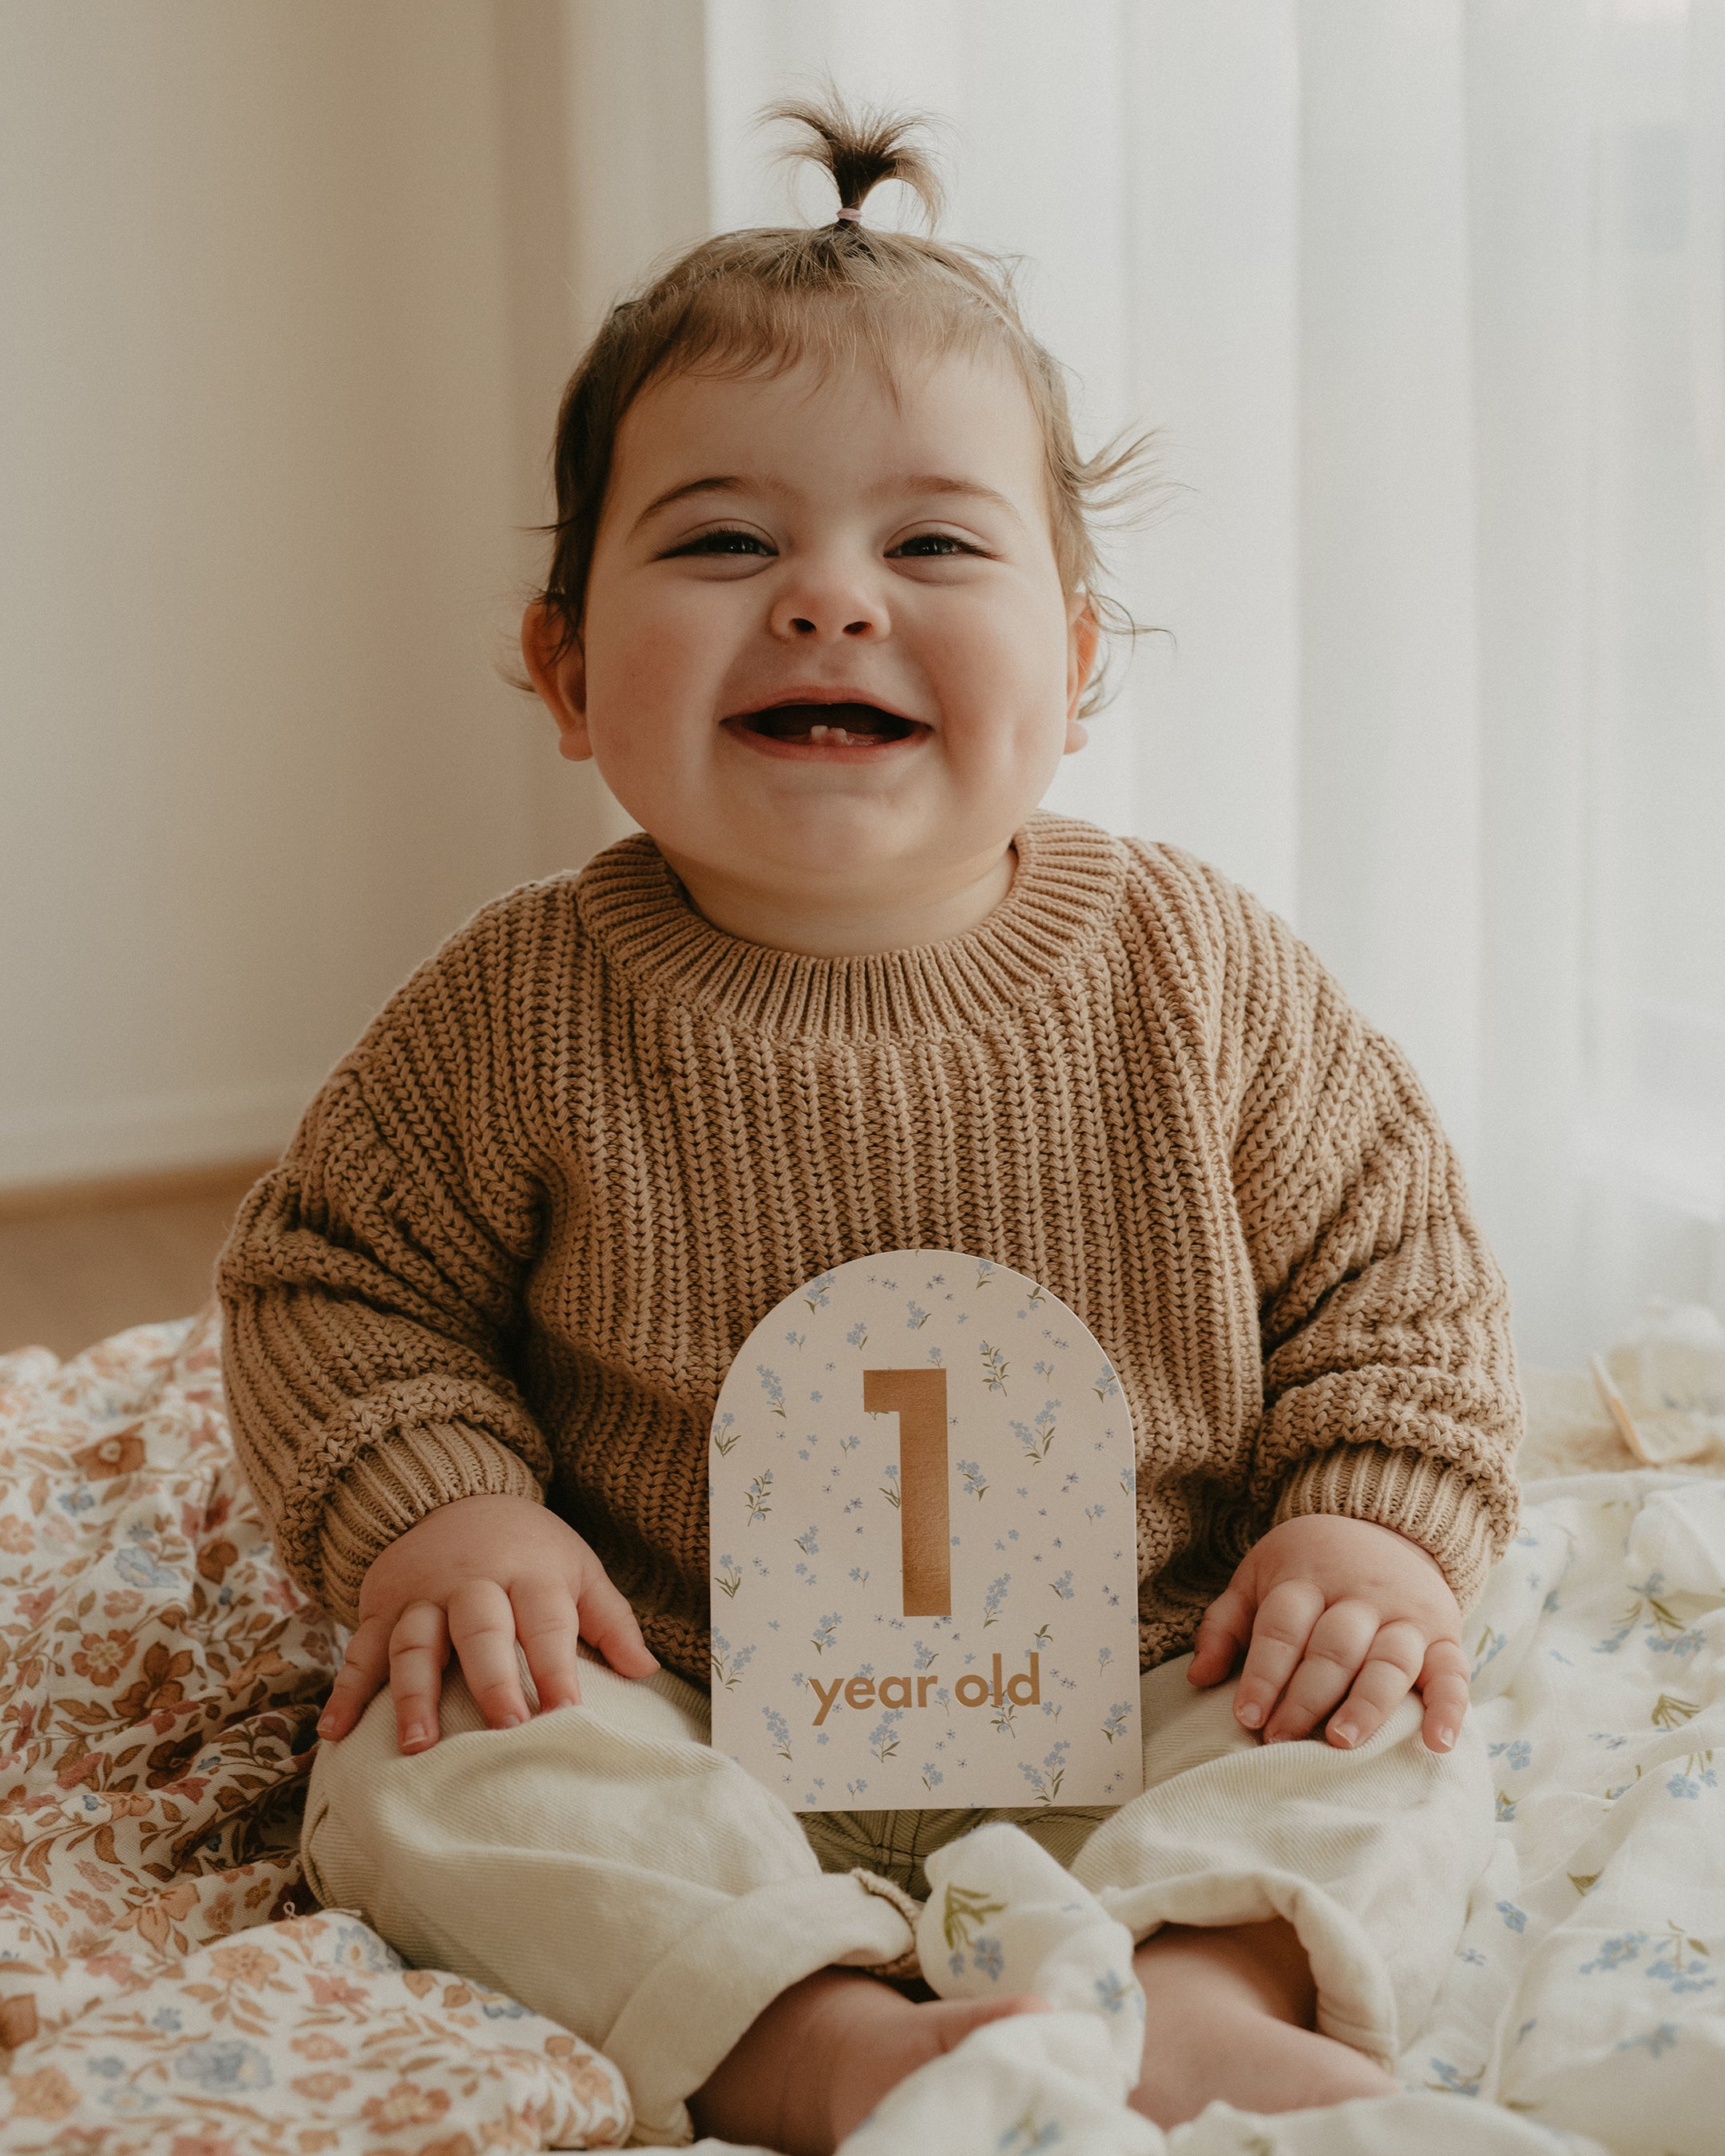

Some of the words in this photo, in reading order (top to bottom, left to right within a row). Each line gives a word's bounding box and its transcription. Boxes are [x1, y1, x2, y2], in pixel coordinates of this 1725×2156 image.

[862, 1369, 952, 1617] 1
[809, 1675, 938, 1726] year
[954, 1652, 1041, 1707] old
